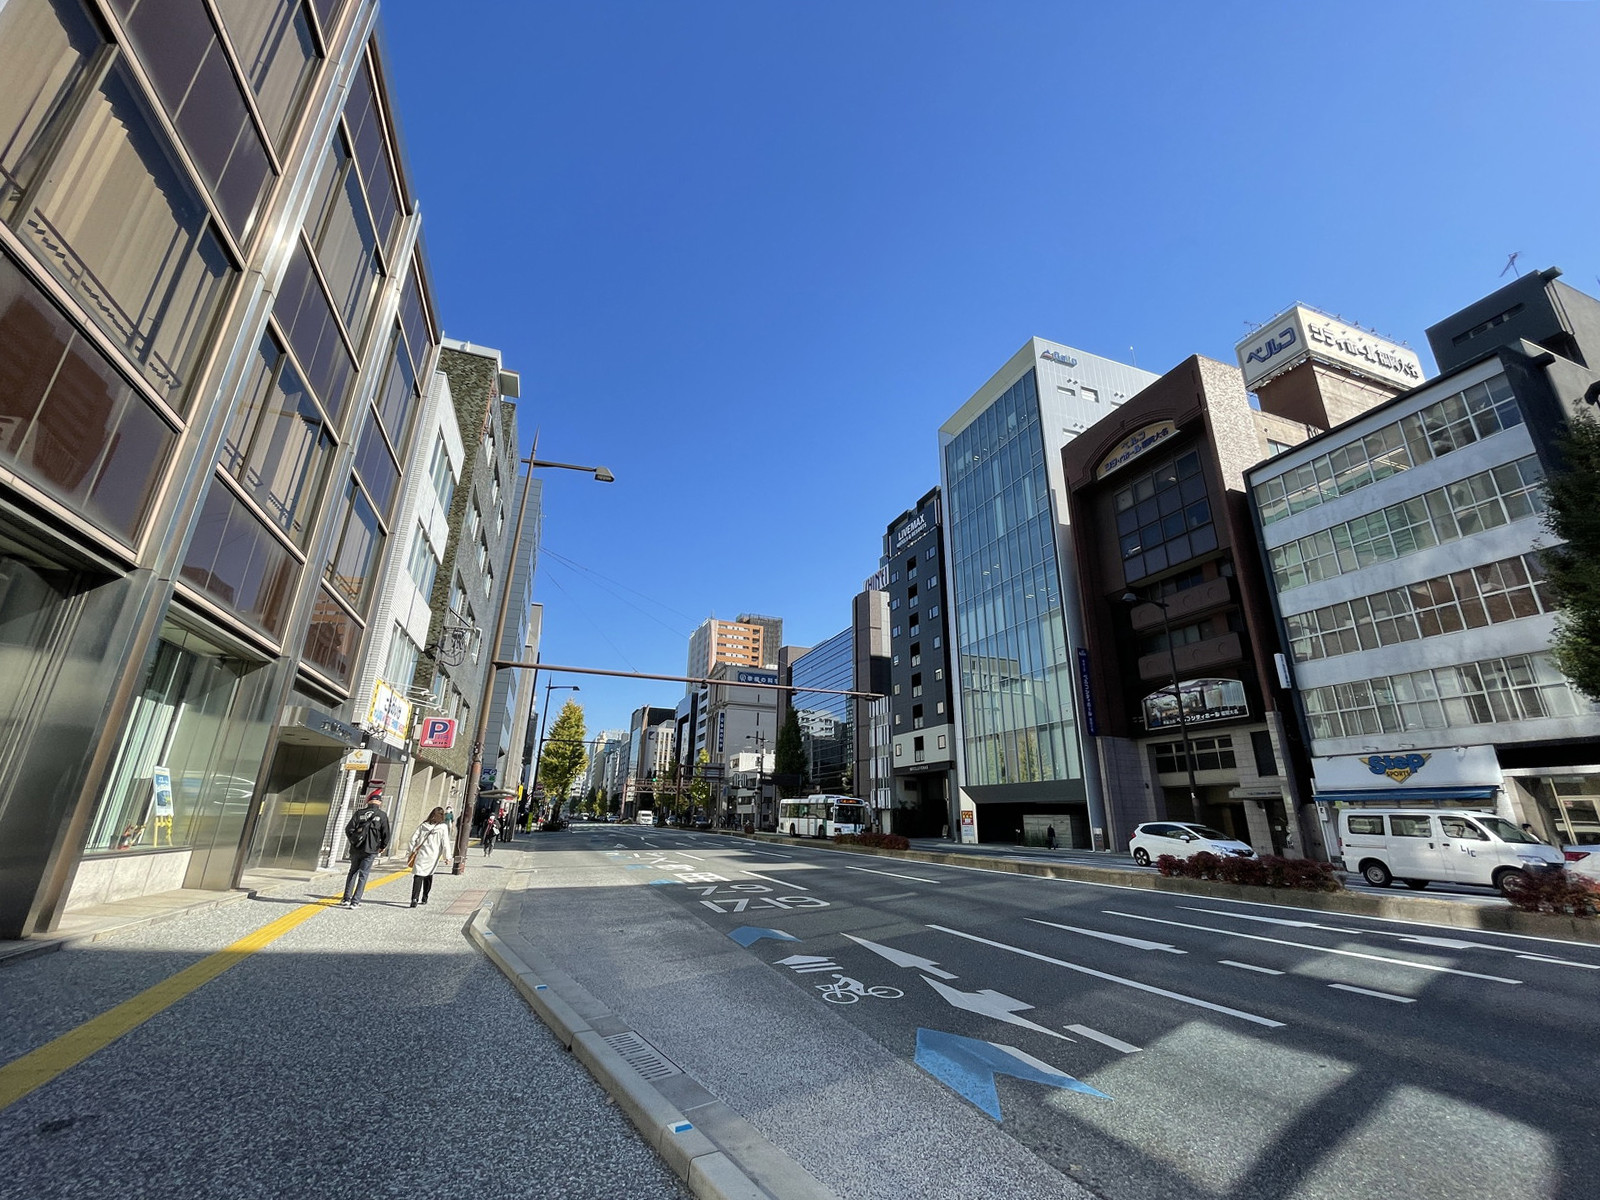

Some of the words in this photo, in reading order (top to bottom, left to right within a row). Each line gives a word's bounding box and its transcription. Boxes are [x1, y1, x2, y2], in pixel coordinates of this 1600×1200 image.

[1246, 326, 1297, 364] ベルコ
[897, 513, 925, 541] LIVEMAX
[1368, 754, 1425, 774] Step
[687, 883, 774, 896] 7-9
[699, 896, 831, 913] 17-19
